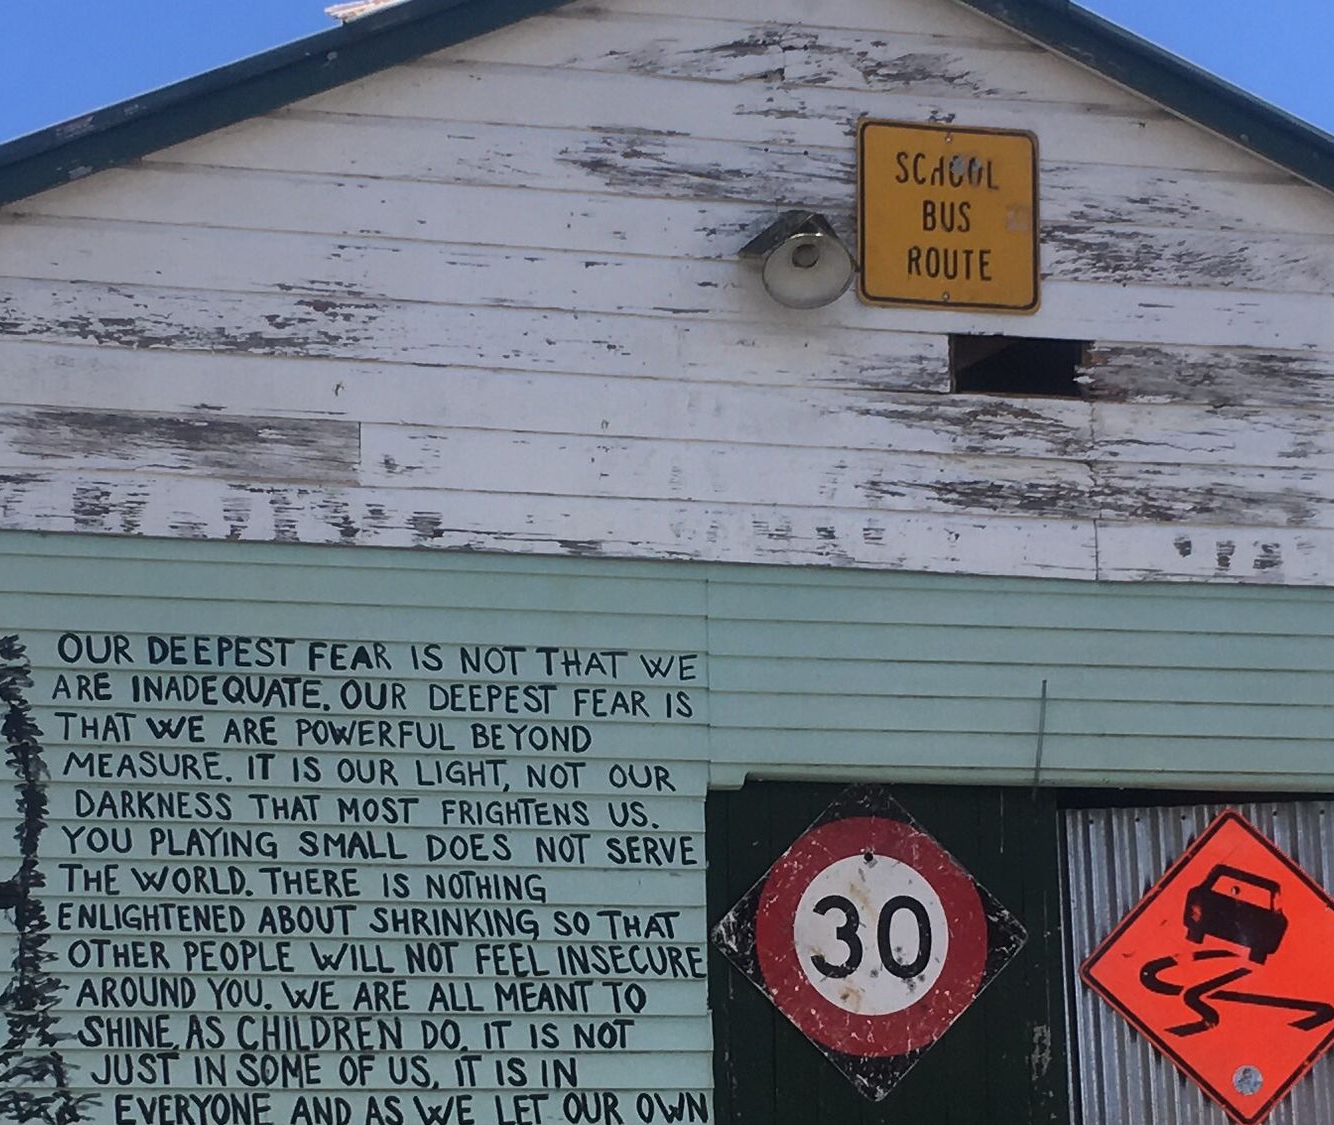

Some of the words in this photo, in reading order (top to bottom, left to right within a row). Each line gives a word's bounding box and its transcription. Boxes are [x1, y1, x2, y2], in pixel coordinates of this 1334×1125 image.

[895, 151, 1000, 191] SCHOOL
[922, 200, 972, 233] BUS
[907, 246, 993, 282] ROUTE
[58, 633, 133, 664] OUR
[148, 635, 295, 667] DEEPEST
[308, 641, 392, 671] FEAR
[411, 644, 443, 671] IS
[461, 646, 526, 675] NOT
[536, 648, 628, 679] THAT
[640, 654, 698, 681] WE
[52, 672, 113, 701] ARE
[132, 675, 330, 711] INADEQUATE.
[340, 679, 406, 711] OUR
[429, 683, 558, 714] DEEPEST
[574, 688, 649, 717] FEAR
[666, 691, 693, 718] IS
[54, 712, 137, 742] THAT
[146, 715, 205, 743] WE
[223, 716, 277, 746] ARE
[296, 718, 455, 750] POWERFUL
[471, 723, 592, 753] BEYOND
[63, 750, 232, 783] MEASURE.
[248, 753, 276, 780] IT
[292, 757, 322, 783] IS
[337, 758, 399, 786] OUR
[416, 759, 511, 792] LIGHT,
[526, 762, 586, 789] NOT
[608, 762, 676, 792] OUR
[75, 788, 232, 821] DARKNESS
[248, 793, 321, 821] THAT
[337, 796, 419, 824] MOST
[441, 798, 590, 827] FRIGHTENS
[608, 801, 660, 829] US.
[61, 825, 133, 854] YOU
[150, 827, 278, 859] PLAYING
[299, 830, 408, 859] SMALL
[426, 833, 512, 862] DOES
[535, 833, 591, 864] NOT
[606, 835, 697, 867] SERVE
[58, 863, 120, 895] THE
[131, 865, 254, 896] WORLD.
[258, 867, 361, 898] THERE
[383, 872, 410, 899] IS
[426, 871, 546, 903] NOTHING
[57, 902, 246, 932] ENLIGHTENED
[258, 904, 357, 935] ABOUT
[369, 907, 539, 941] SHRINKING
[554, 910, 590, 937] SO
[596, 910, 680, 939] THAT
[809, 893, 933, 980] 30
[68, 938, 171, 969] OTHER
[183, 941, 295, 972] PEOPLE
[310, 942, 395, 973] WILL
[405, 942, 459, 974] NOT
[476, 943, 549, 978] FEEL
[557, 945, 707, 979] INSECURE
[76, 976, 197, 1008] AROUND
[207, 977, 273, 1010] YOU.
[281, 980, 340, 1010] WE
[353, 980, 410, 1011] ARE
[428, 981, 484, 1012] ALL
[494, 980, 593, 1012] MEANT
[602, 981, 646, 1014] TO
[186, 1015, 226, 1049] AS
[237, 1016, 402, 1050] CHILDREN
[484, 1020, 512, 1049] IT
[530, 1022, 560, 1049] IS
[574, 1019, 635, 1049] NOT
[91, 1052, 180, 1085] JUST
[195, 1054, 226, 1086] IN
[236, 1054, 321, 1087] SOME
[339, 1054, 375, 1086] OF
[455, 1055, 482, 1087] IT
[496, 1057, 527, 1087] IS
[541, 1057, 577, 1088] IN
[495, 1093, 549, 1125] LET
[563, 1092, 624, 1125] OUR
[636, 1092, 709, 1124] OWN
